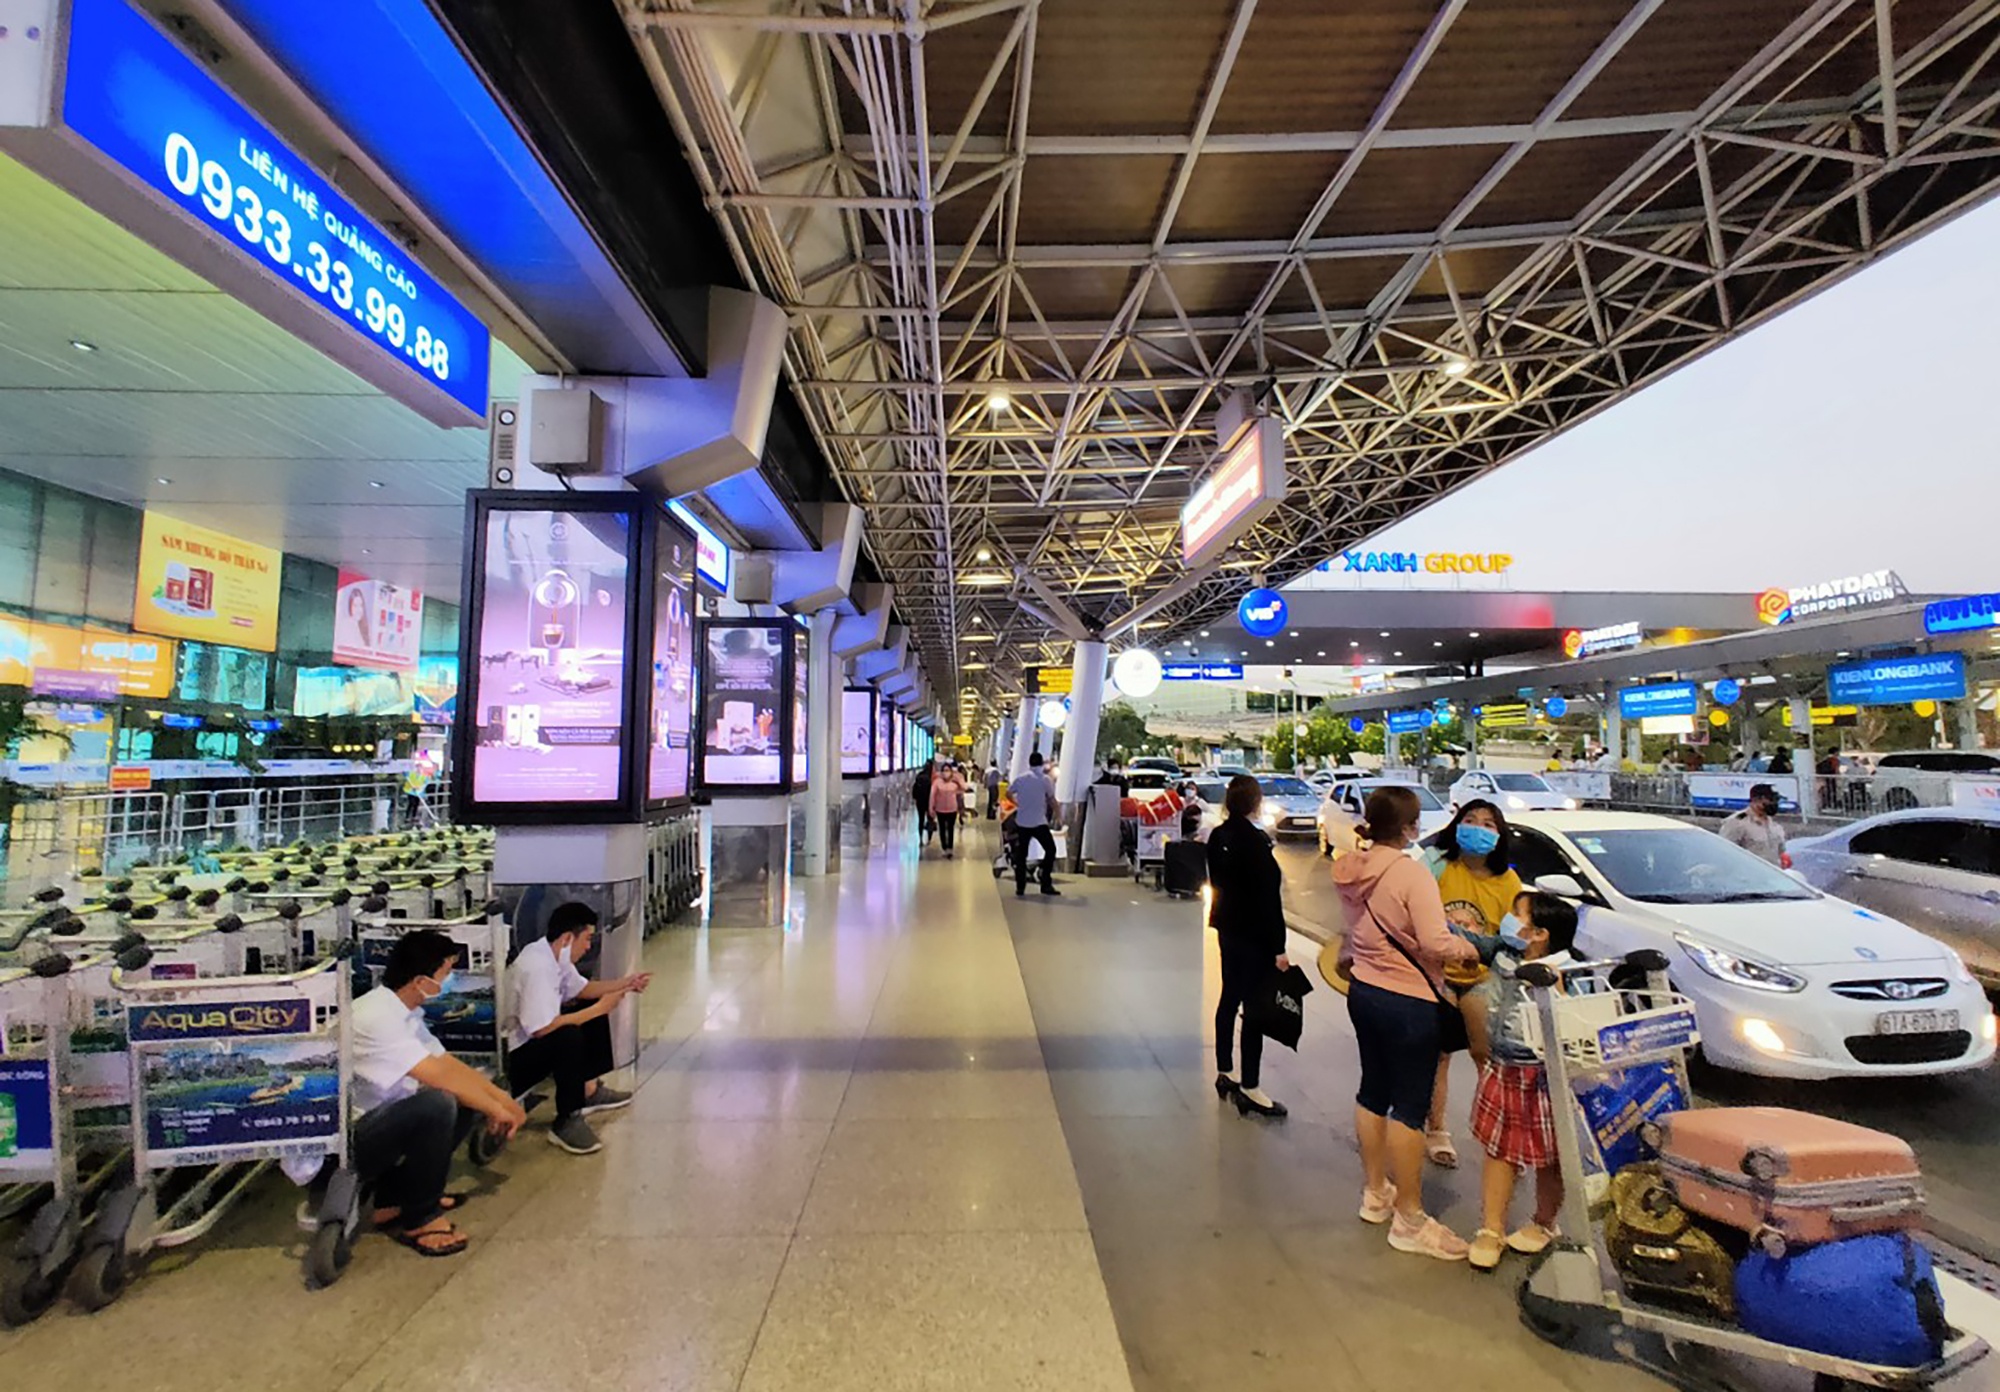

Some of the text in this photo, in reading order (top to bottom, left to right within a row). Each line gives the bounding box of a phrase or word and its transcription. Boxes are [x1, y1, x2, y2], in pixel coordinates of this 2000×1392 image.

[239, 137, 417, 300] LIÊN HỆ QUẢNG CÁO
[164, 132, 449, 381] 0933.33.99.88
[1343, 551, 1417, 573] XANH
[1425, 553, 1513, 574] GROUP
[1246, 607, 1275, 621] VIB
[1791, 588, 1895, 617] CORPORATION
[1834, 659, 1955, 685] KIENLONGBANK
